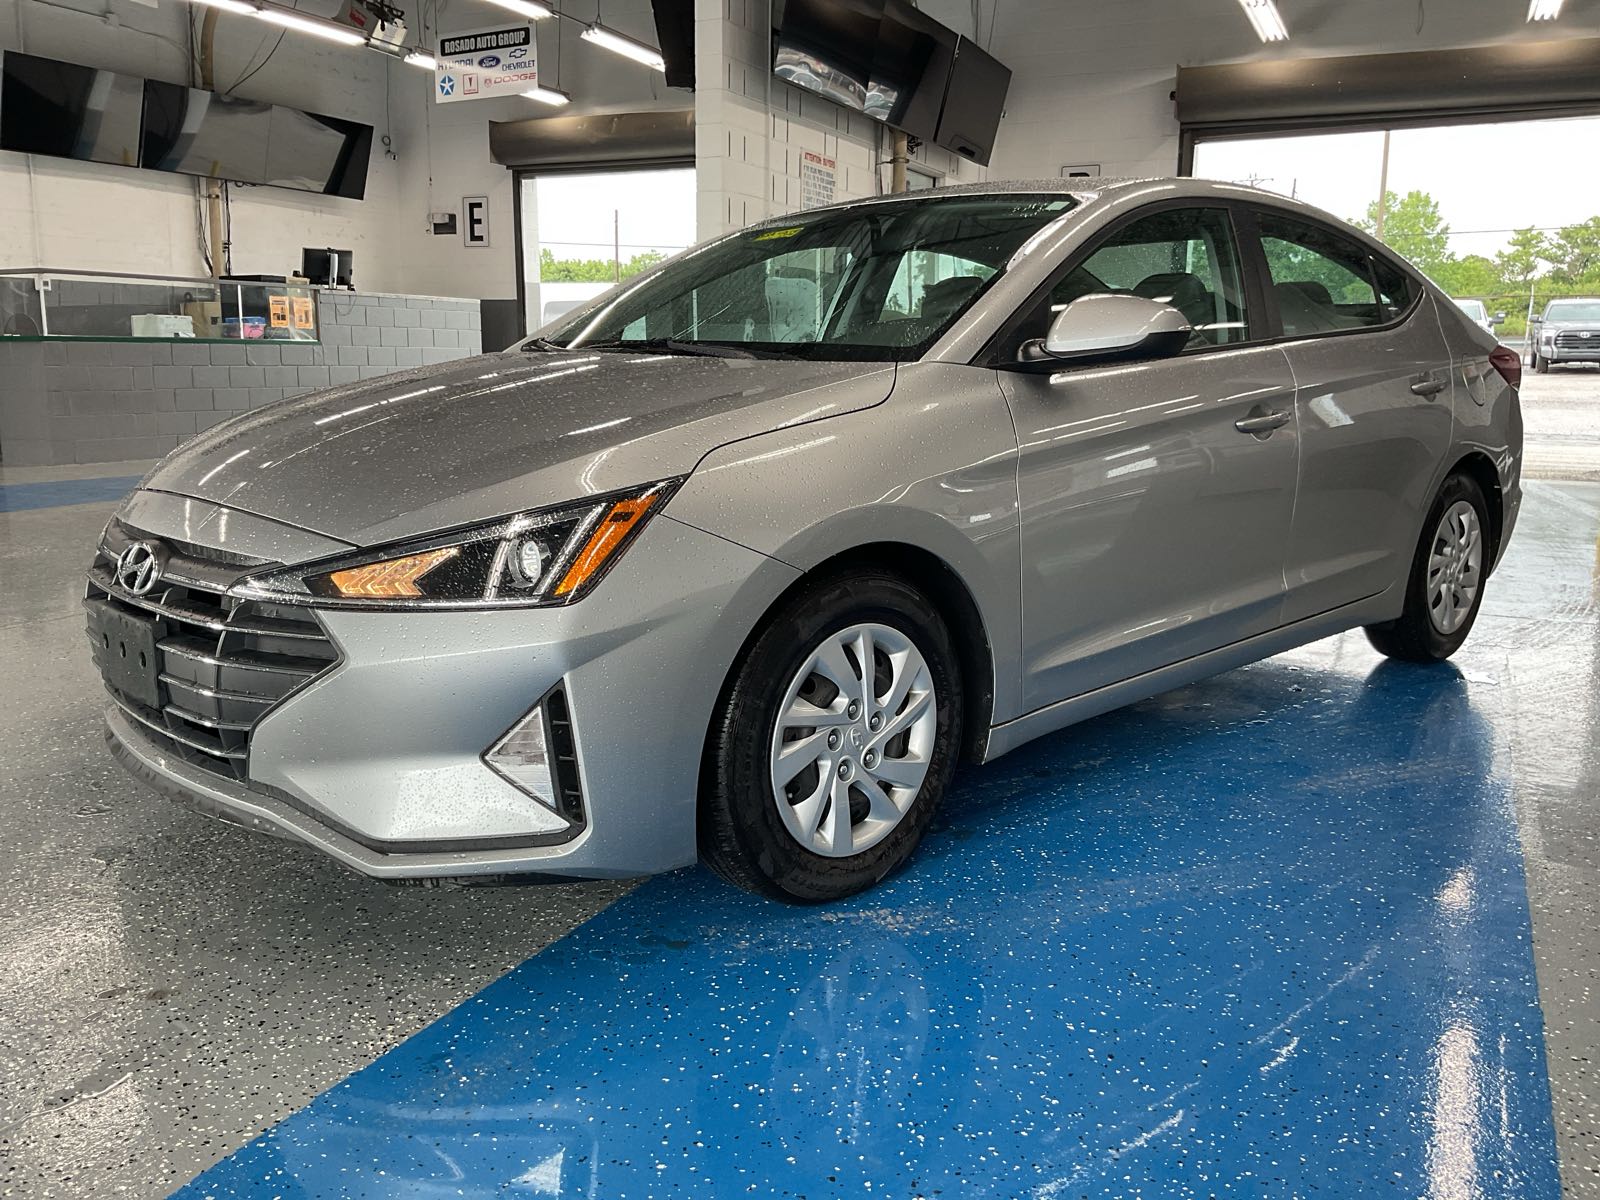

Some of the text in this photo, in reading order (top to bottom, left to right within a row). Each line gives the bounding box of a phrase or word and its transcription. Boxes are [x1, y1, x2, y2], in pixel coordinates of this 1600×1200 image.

[444, 31, 525, 53] ROSADO AUTO GROUP
[482, 57, 497, 67] Ford
[502, 60, 535, 71] CHEVROLET
[494, 72, 537, 84] DODGE
[468, 202, 484, 241] E
